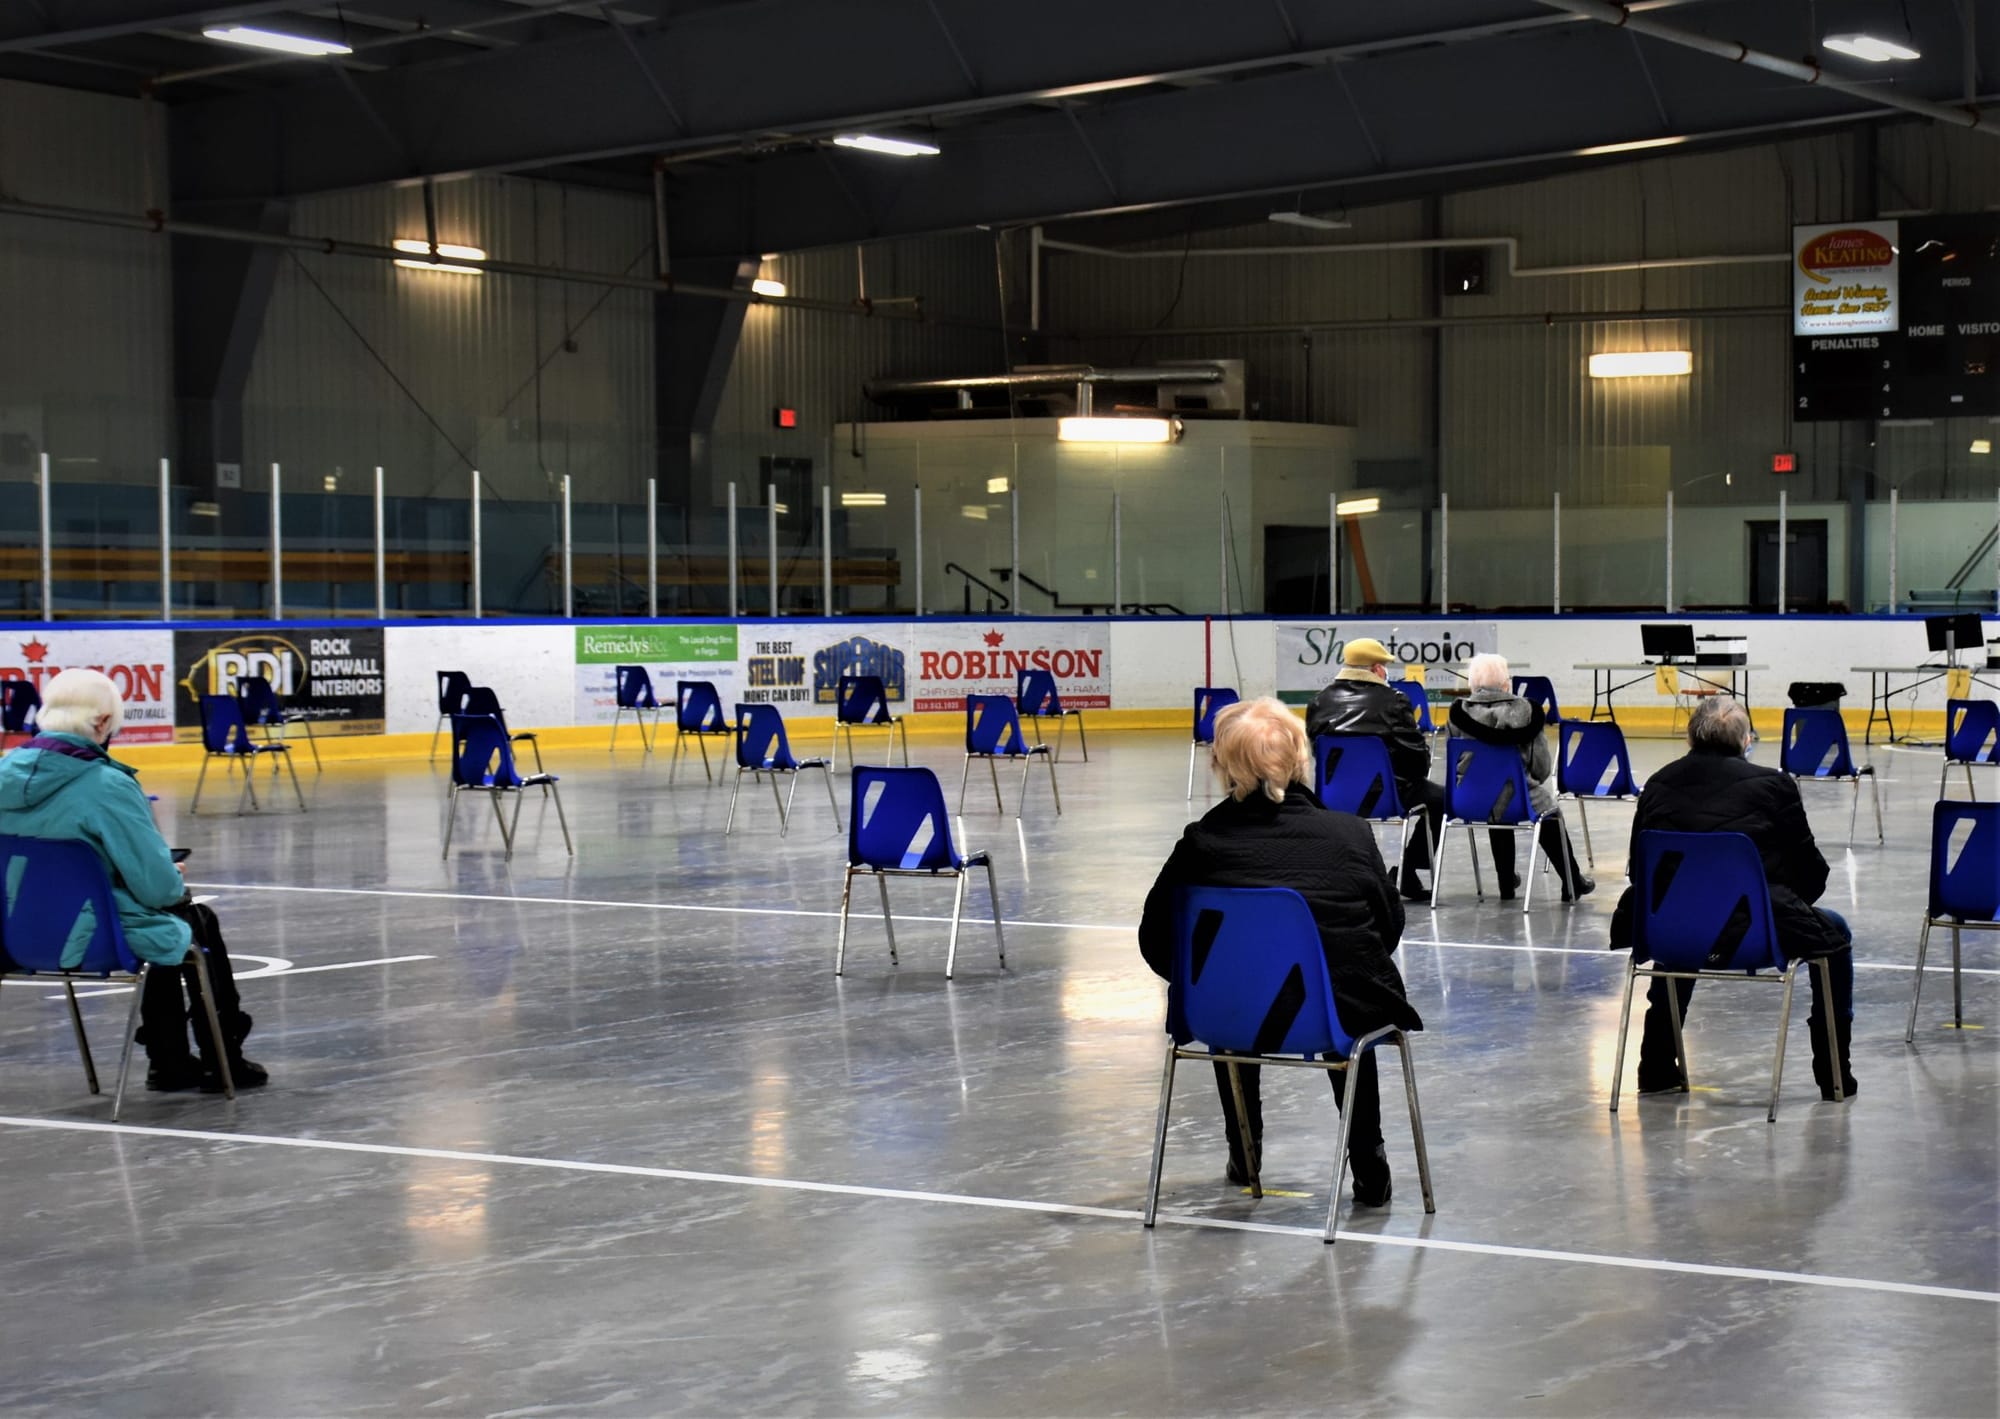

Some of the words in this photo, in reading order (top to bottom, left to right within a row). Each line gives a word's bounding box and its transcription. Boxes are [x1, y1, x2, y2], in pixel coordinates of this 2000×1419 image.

[1814, 246, 1889, 264] KEATING
[1941, 277, 1971, 288] PERIOD
[1908, 324, 1945, 337] HOME
[1958, 322, 2000, 335] VISITO
[1811, 337, 1880, 351] PENALTIES
[1799, 362, 1806, 374] 1
[1883, 360, 1890, 369] 3
[1883, 383, 1890, 392] 4
[1799, 396, 1808, 408] 2
[310, 639, 351, 656] ROCK
[756, 642, 770, 654] THE
[772, 641, 792, 654] BEST
[1298, 627, 1475, 667] Shtopia
[311, 658, 380, 676] DRYWALL
[813, 636, 905, 688] SUPERIOR
[920, 650, 1102, 680] ROBINSON
[748, 657, 776, 687] STEEL
[777, 656, 805, 686] ROOF
[311, 678, 382, 697] INTERIORS
[920, 686, 975, 696] CHRYSLER
[986, 686, 1018, 696] DODG
[743, 690, 770, 703] MONEY
[772, 689, 788, 702] CAN
[790, 688, 810, 702] BUY!
